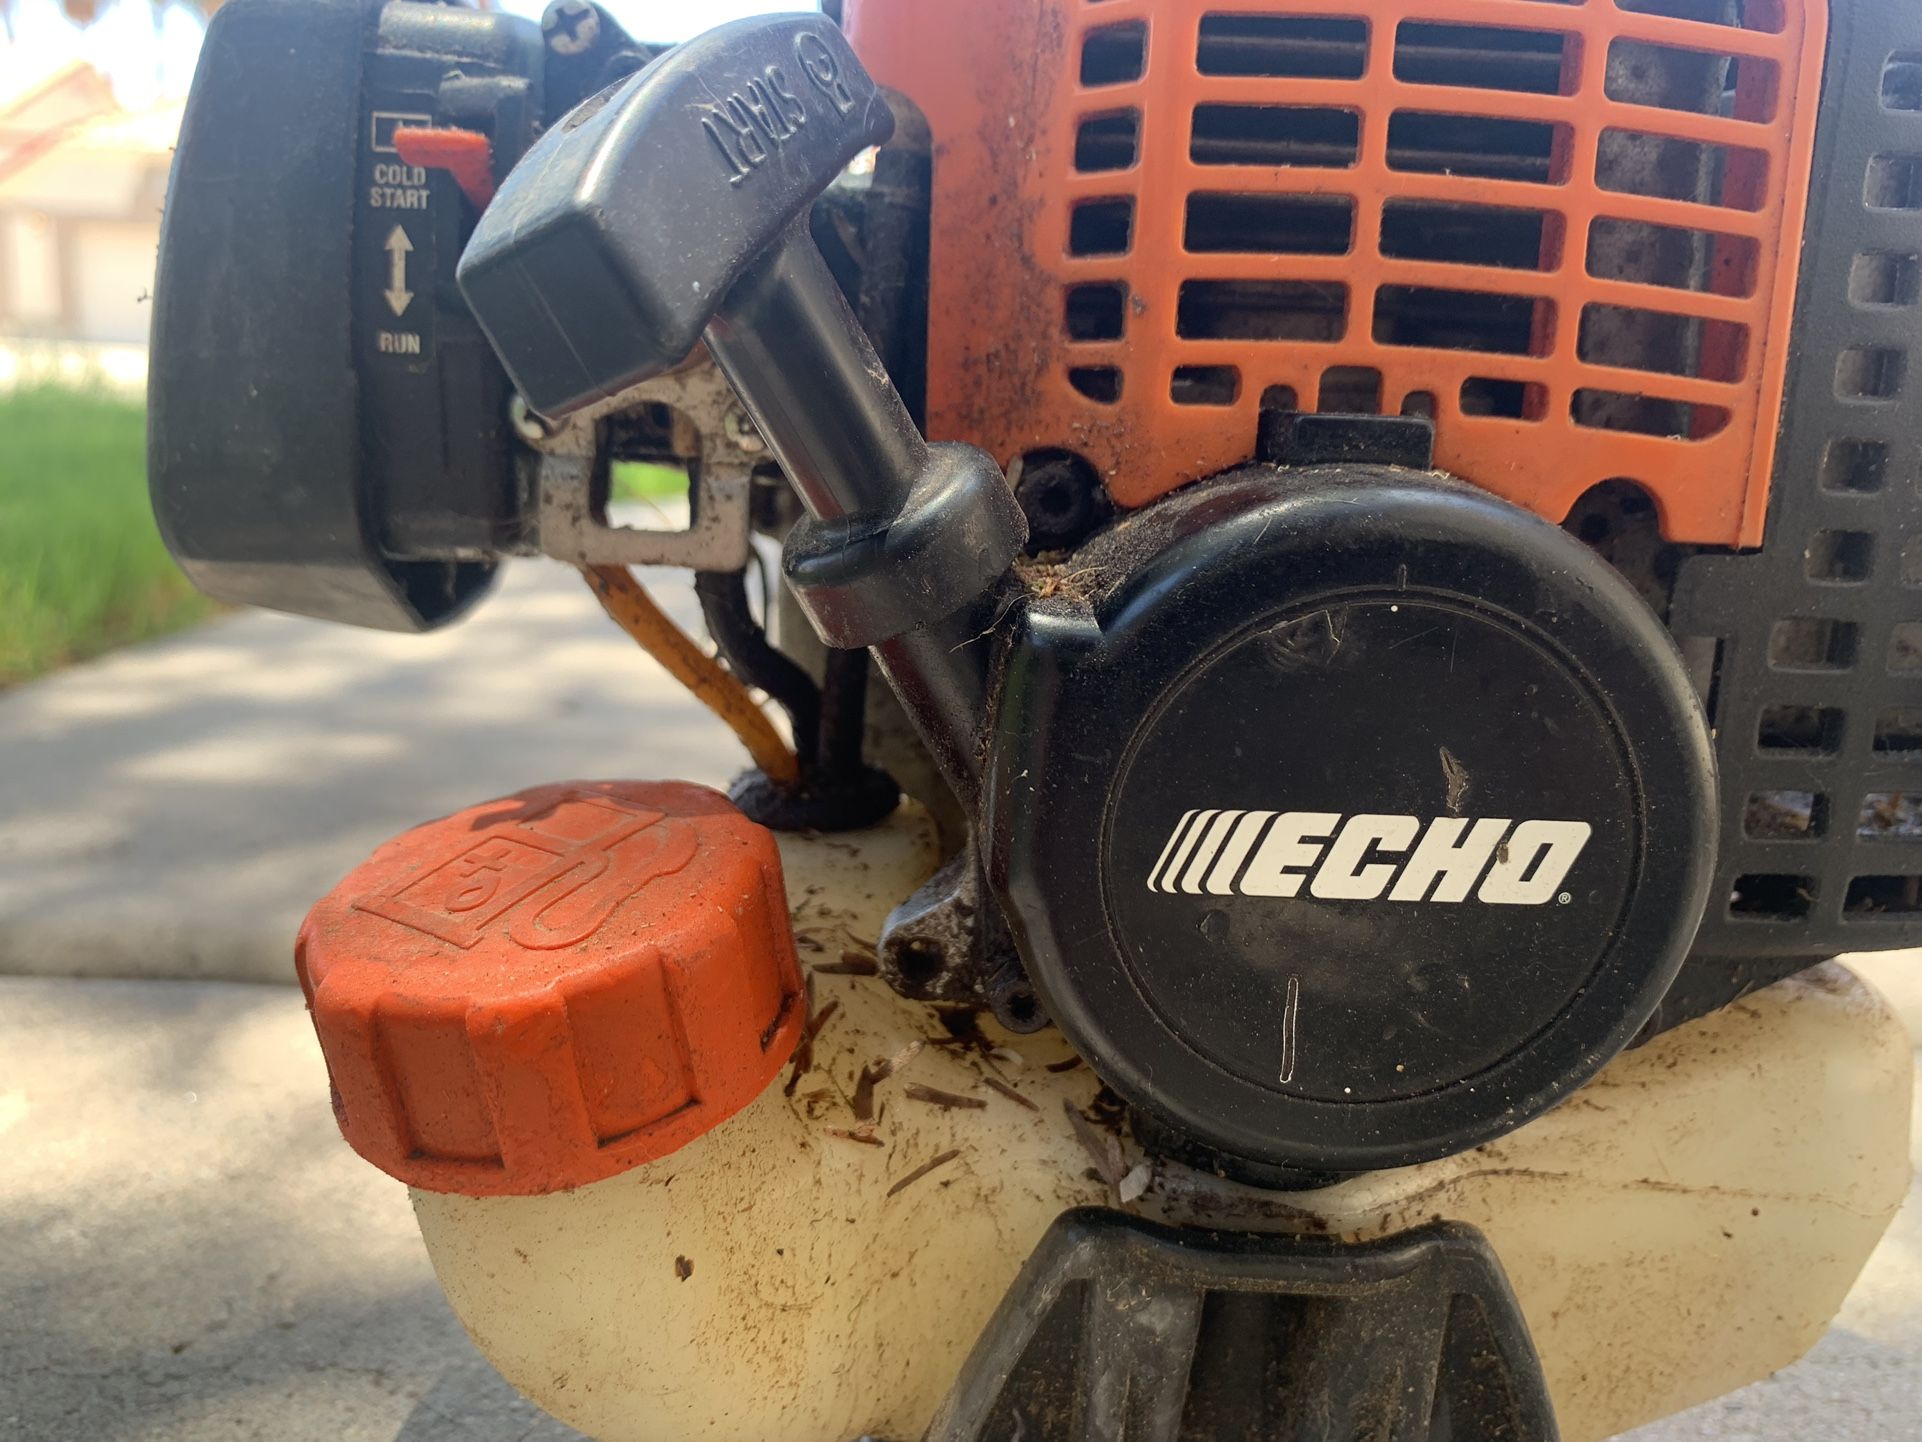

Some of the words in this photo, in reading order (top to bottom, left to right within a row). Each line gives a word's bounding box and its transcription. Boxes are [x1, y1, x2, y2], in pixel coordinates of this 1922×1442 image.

[701, 65, 806, 186] START
[374, 163, 427, 186] COLD
[370, 187, 430, 210] START
[378, 332, 421, 354] RUN
[1239, 811, 1592, 905] ECHO
